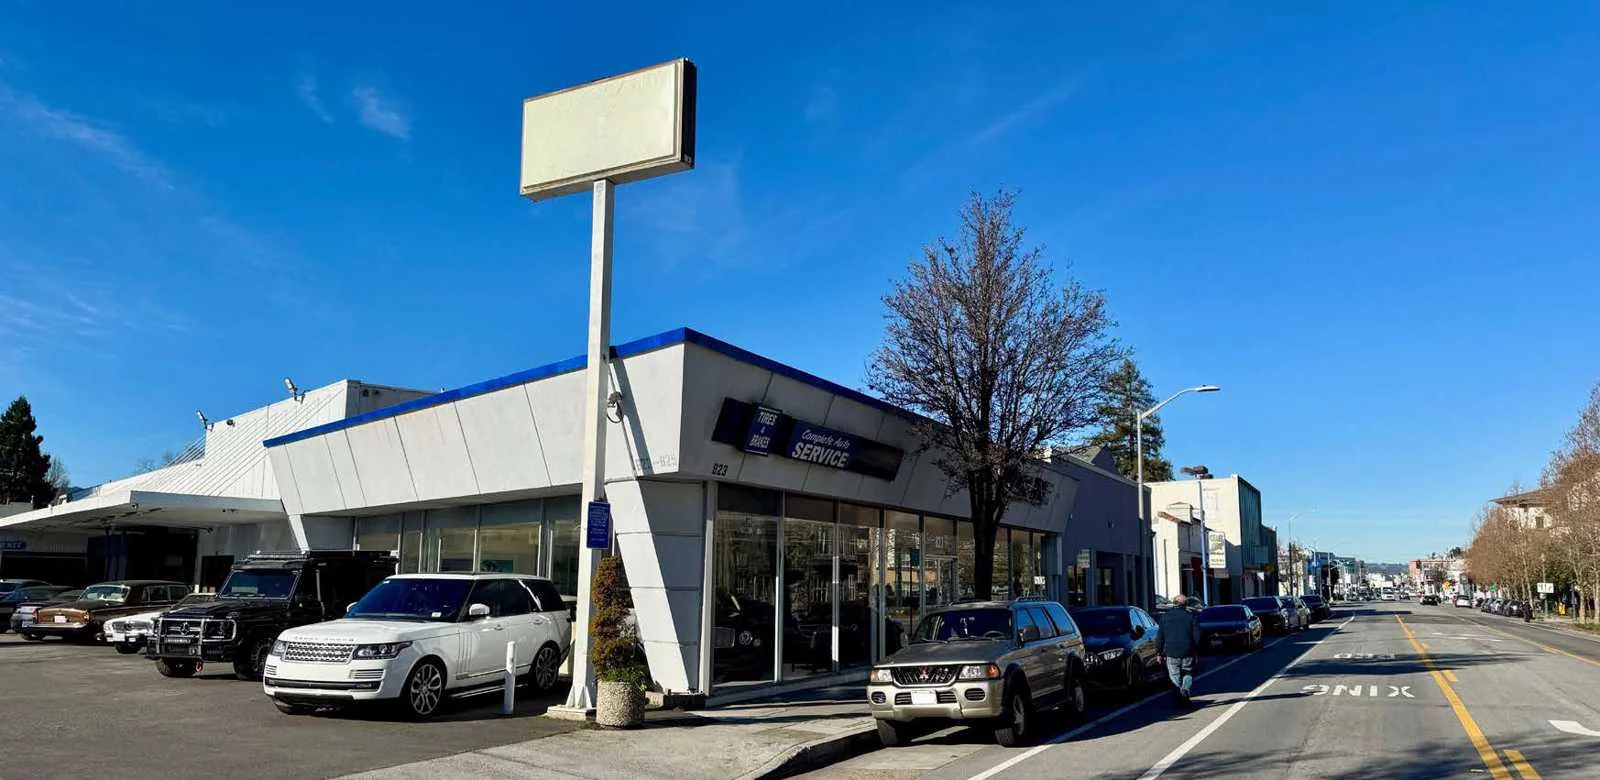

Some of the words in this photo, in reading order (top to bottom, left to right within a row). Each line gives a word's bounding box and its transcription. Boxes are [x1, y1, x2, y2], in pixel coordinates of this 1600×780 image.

[757, 411, 778, 426] TIRES
[801, 429, 835, 446] Complete
[833, 437, 851, 449] Auto
[791, 442, 850, 468] SERVICE
[1302, 684, 1416, 698] XING
